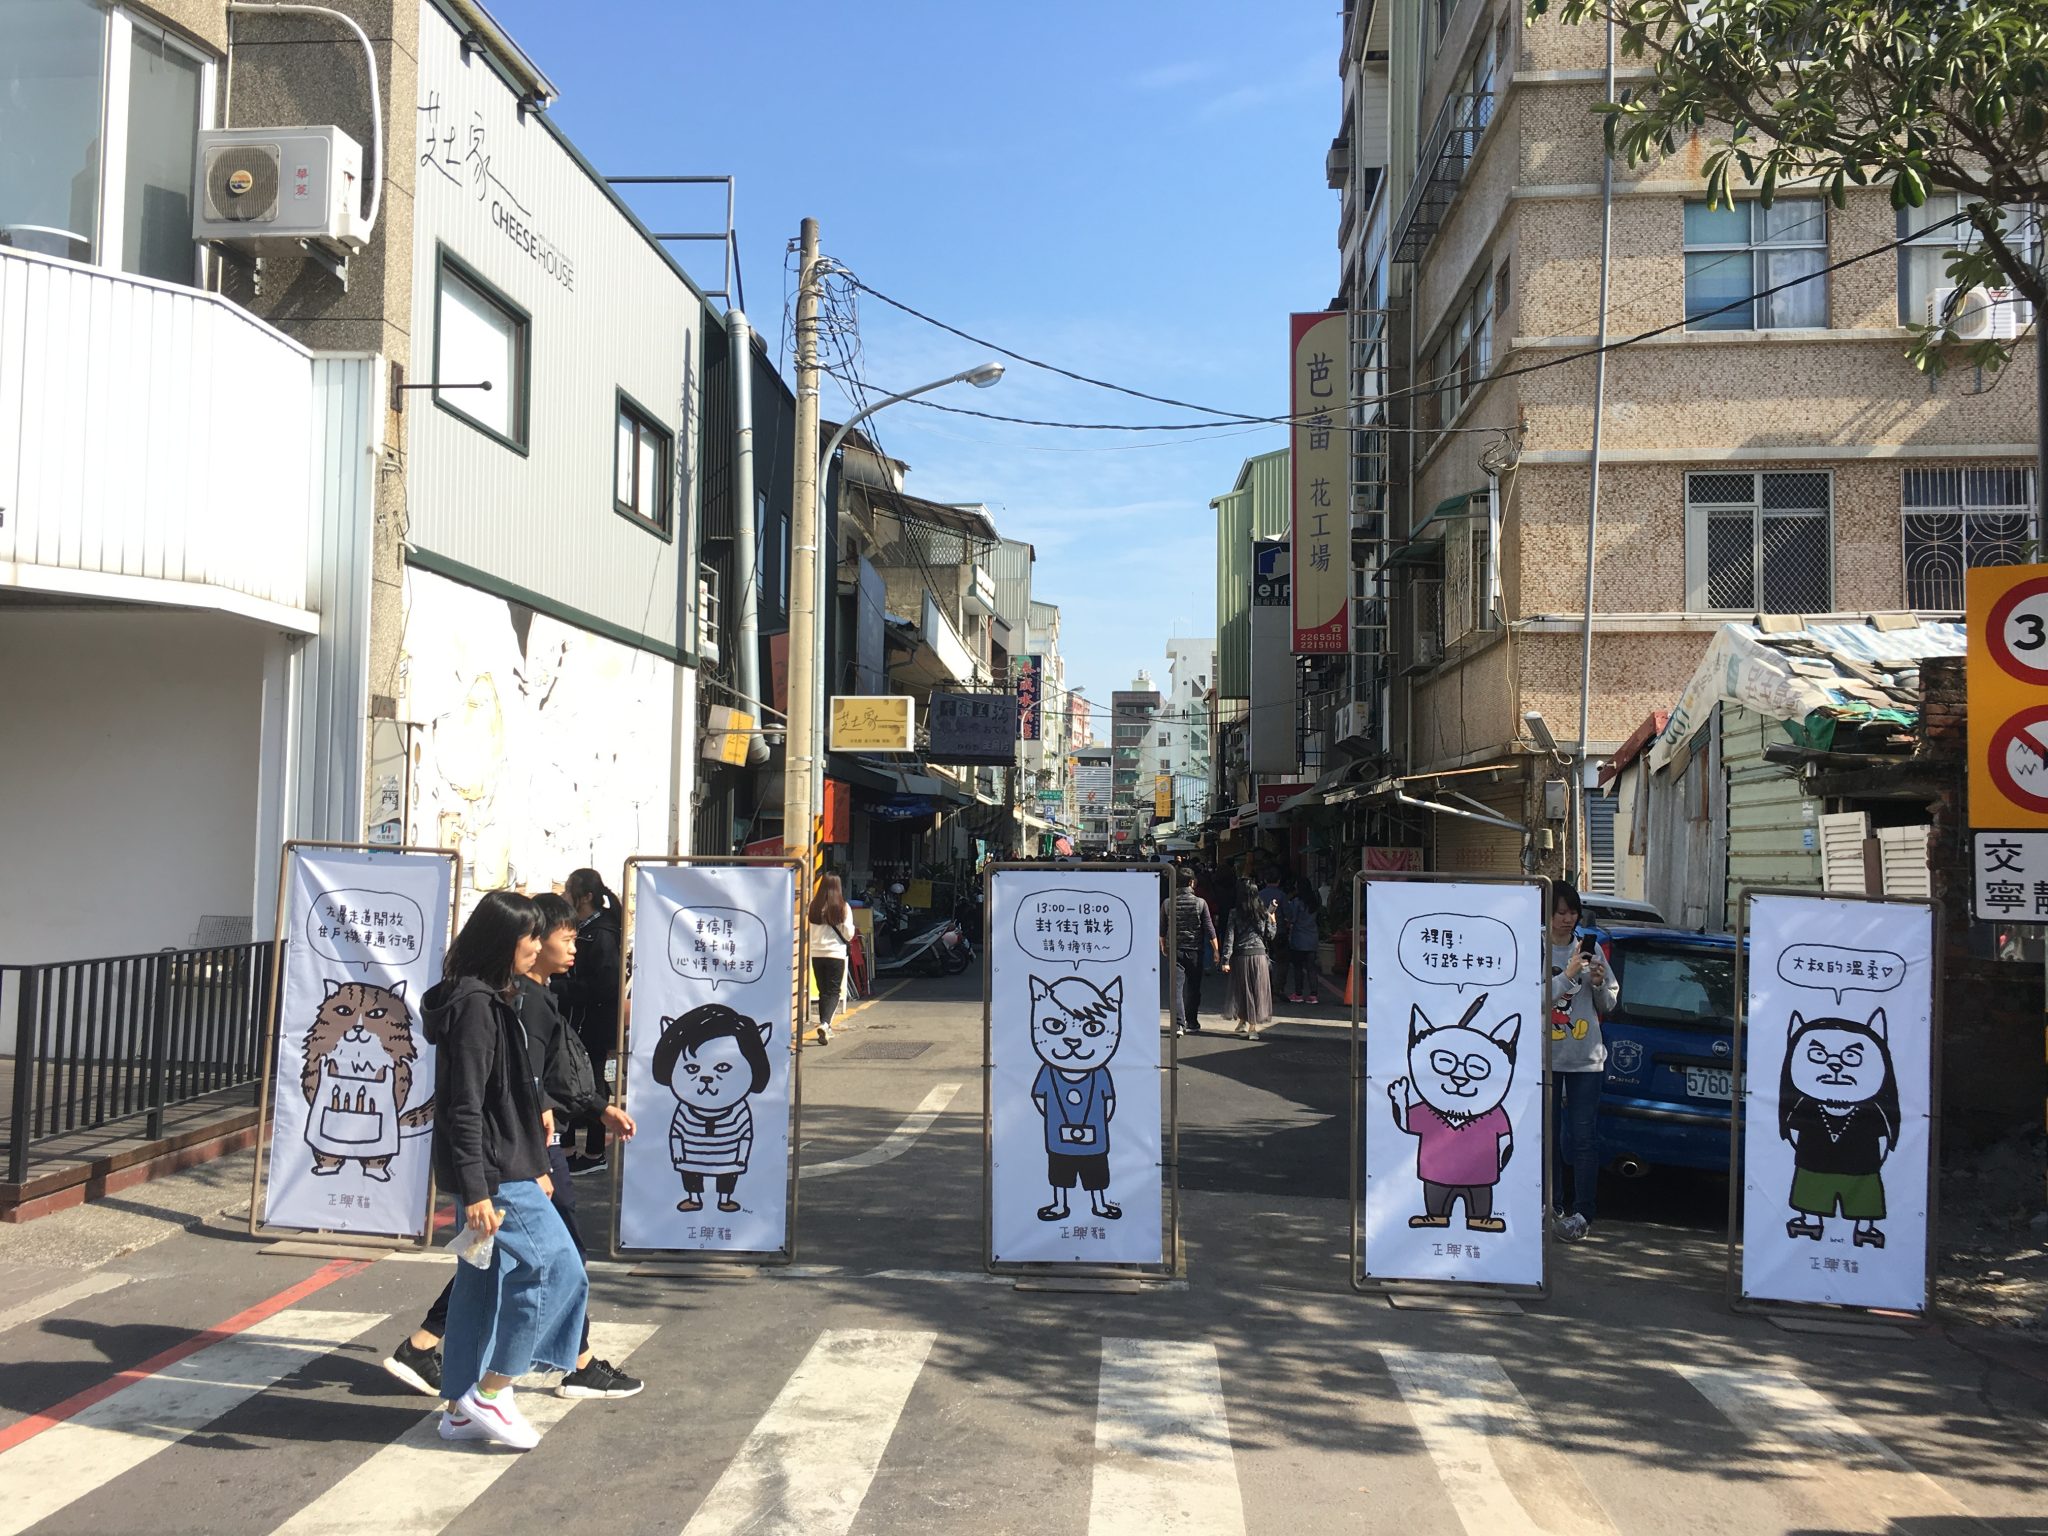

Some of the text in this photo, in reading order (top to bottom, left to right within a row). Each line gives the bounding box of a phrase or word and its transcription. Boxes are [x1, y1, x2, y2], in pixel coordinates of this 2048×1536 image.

[1300, 633, 1341, 641] 2265515
[1035, 918, 1114, 935] 封街散步
[694, 939, 736, 957] 路卡順
